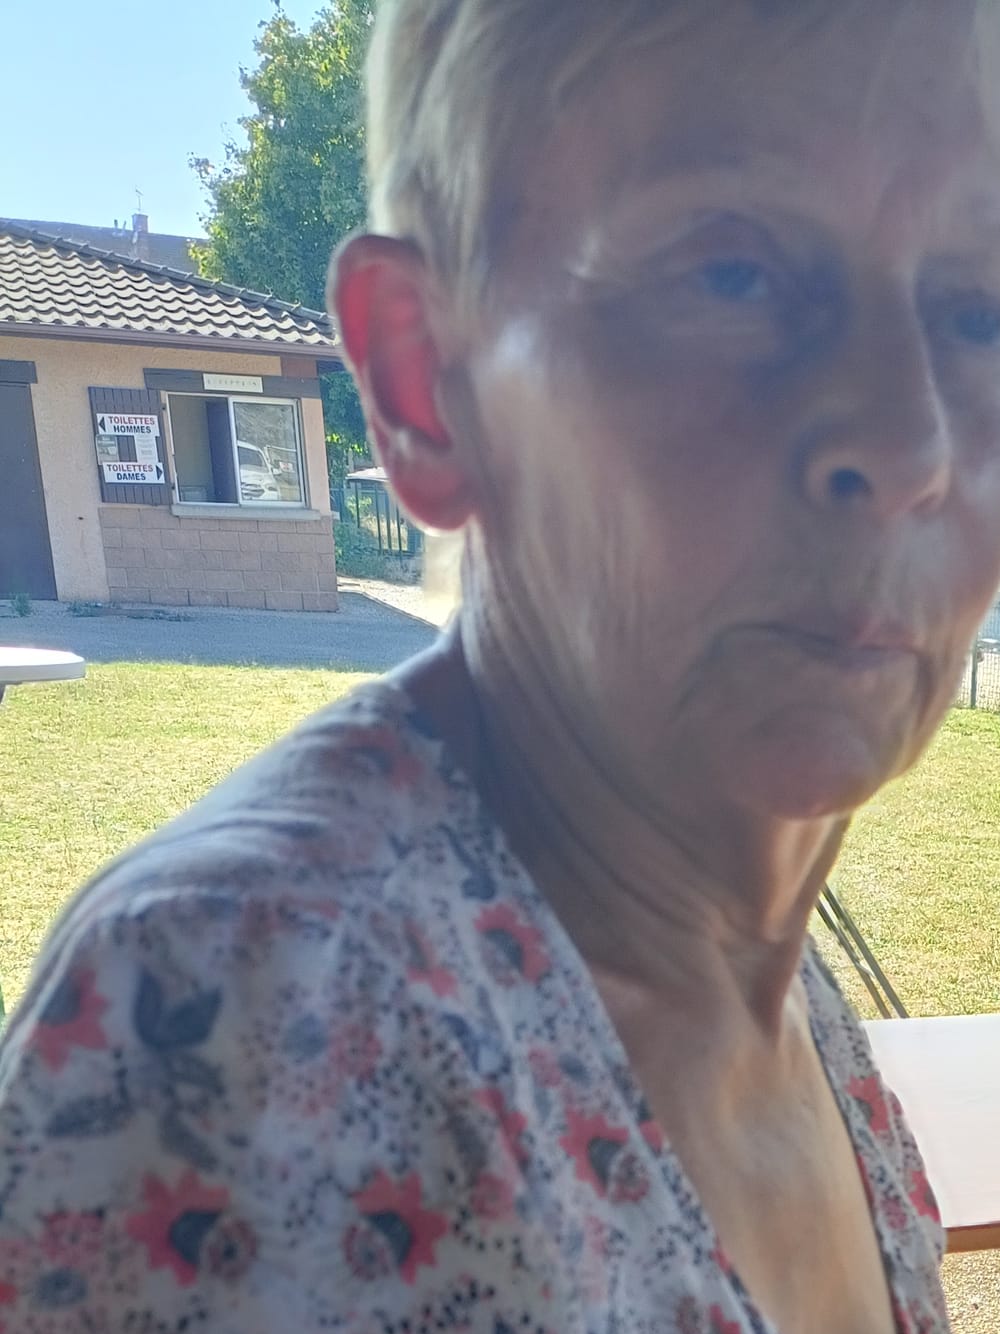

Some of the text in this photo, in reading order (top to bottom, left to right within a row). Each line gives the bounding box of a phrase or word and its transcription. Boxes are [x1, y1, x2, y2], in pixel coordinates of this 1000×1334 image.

[108, 416, 155, 425] TOILETTES
[113, 425, 152, 434] HOMMES
[106, 464, 154, 473] TOILETTES
[116, 472, 146, 481] DAMES
